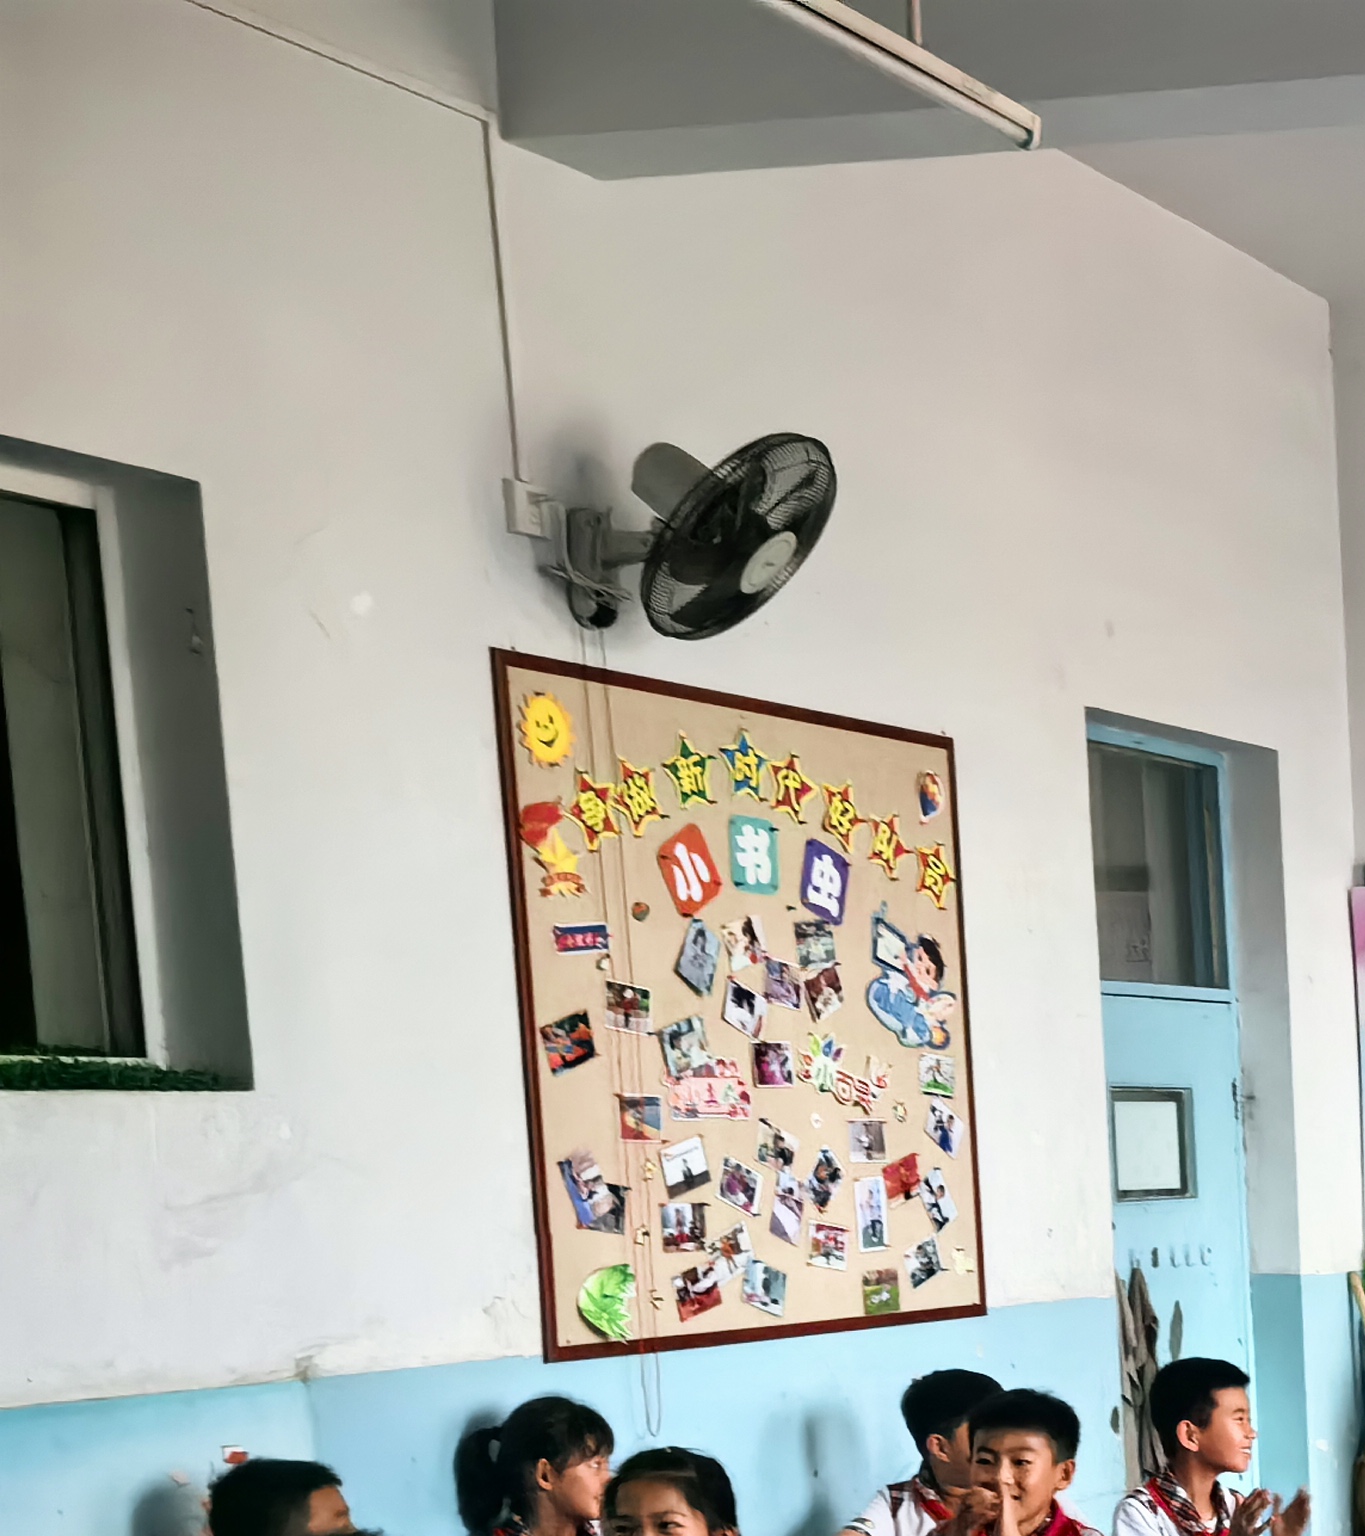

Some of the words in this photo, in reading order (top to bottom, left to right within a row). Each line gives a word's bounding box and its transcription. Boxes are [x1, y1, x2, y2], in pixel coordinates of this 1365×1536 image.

[578, 750, 948, 894] 争做新时代好队员
[672, 823, 842, 918] 小书虫
